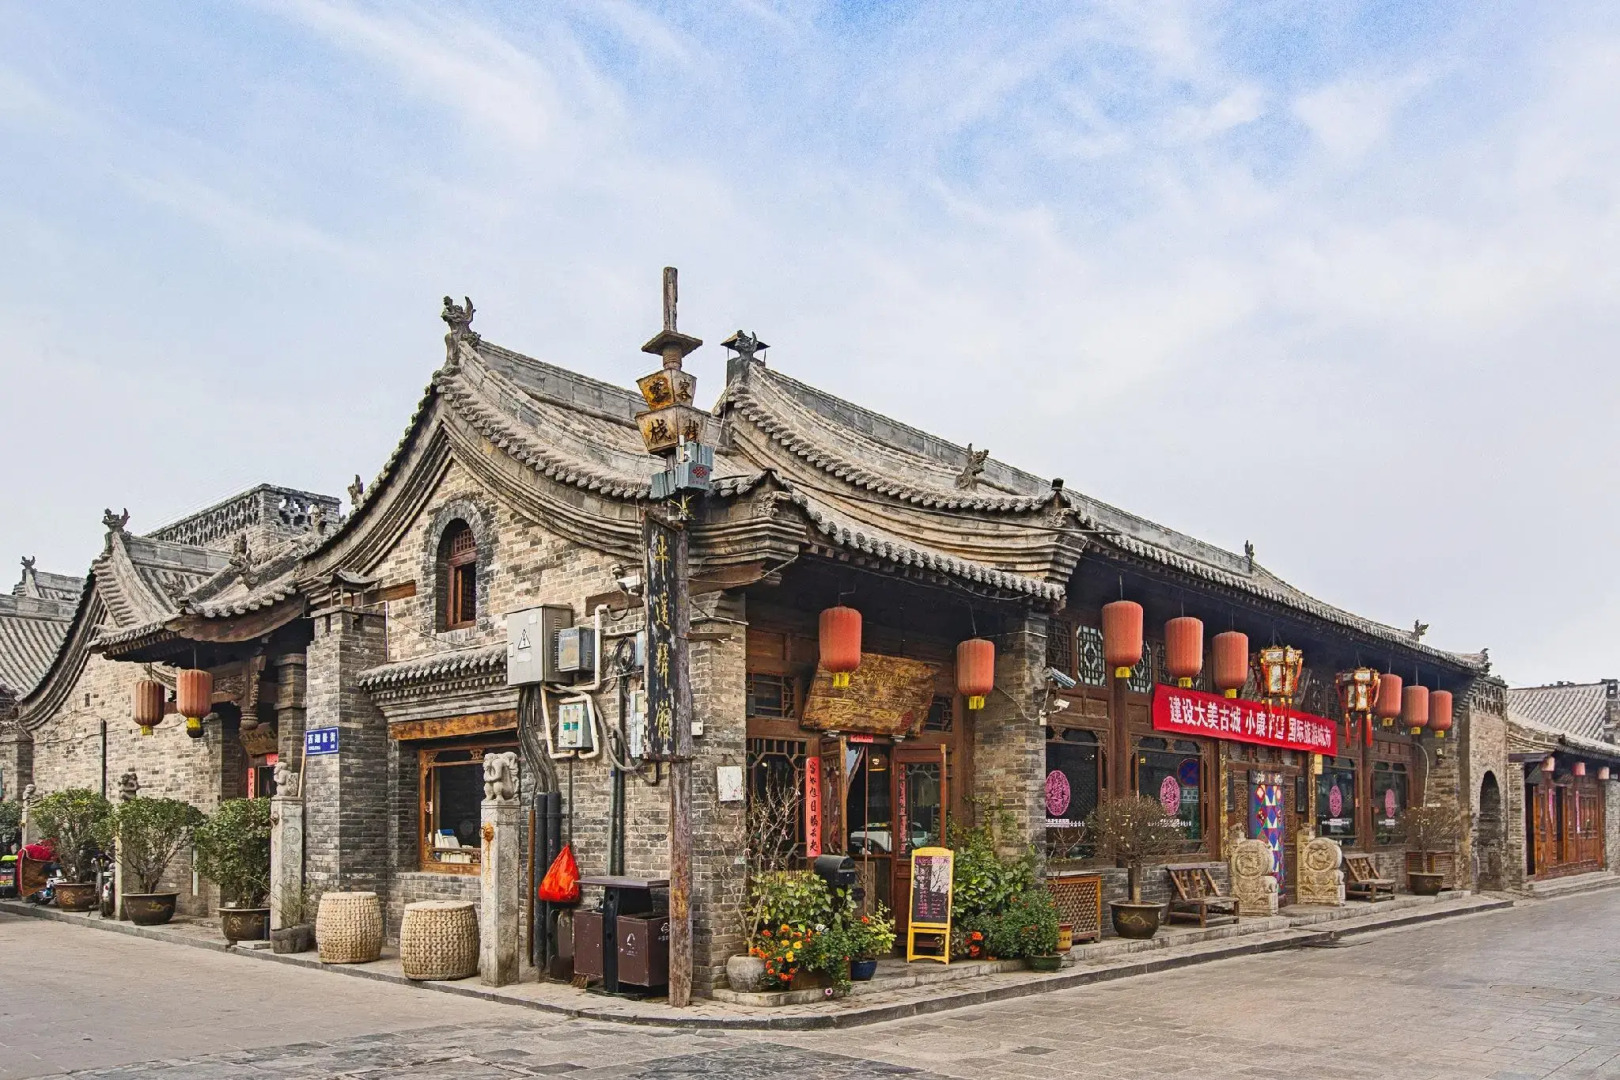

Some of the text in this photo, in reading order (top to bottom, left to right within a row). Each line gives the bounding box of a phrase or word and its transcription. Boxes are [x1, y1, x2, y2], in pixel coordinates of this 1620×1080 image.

[1168, 695, 1241, 734] 建设大美古城
